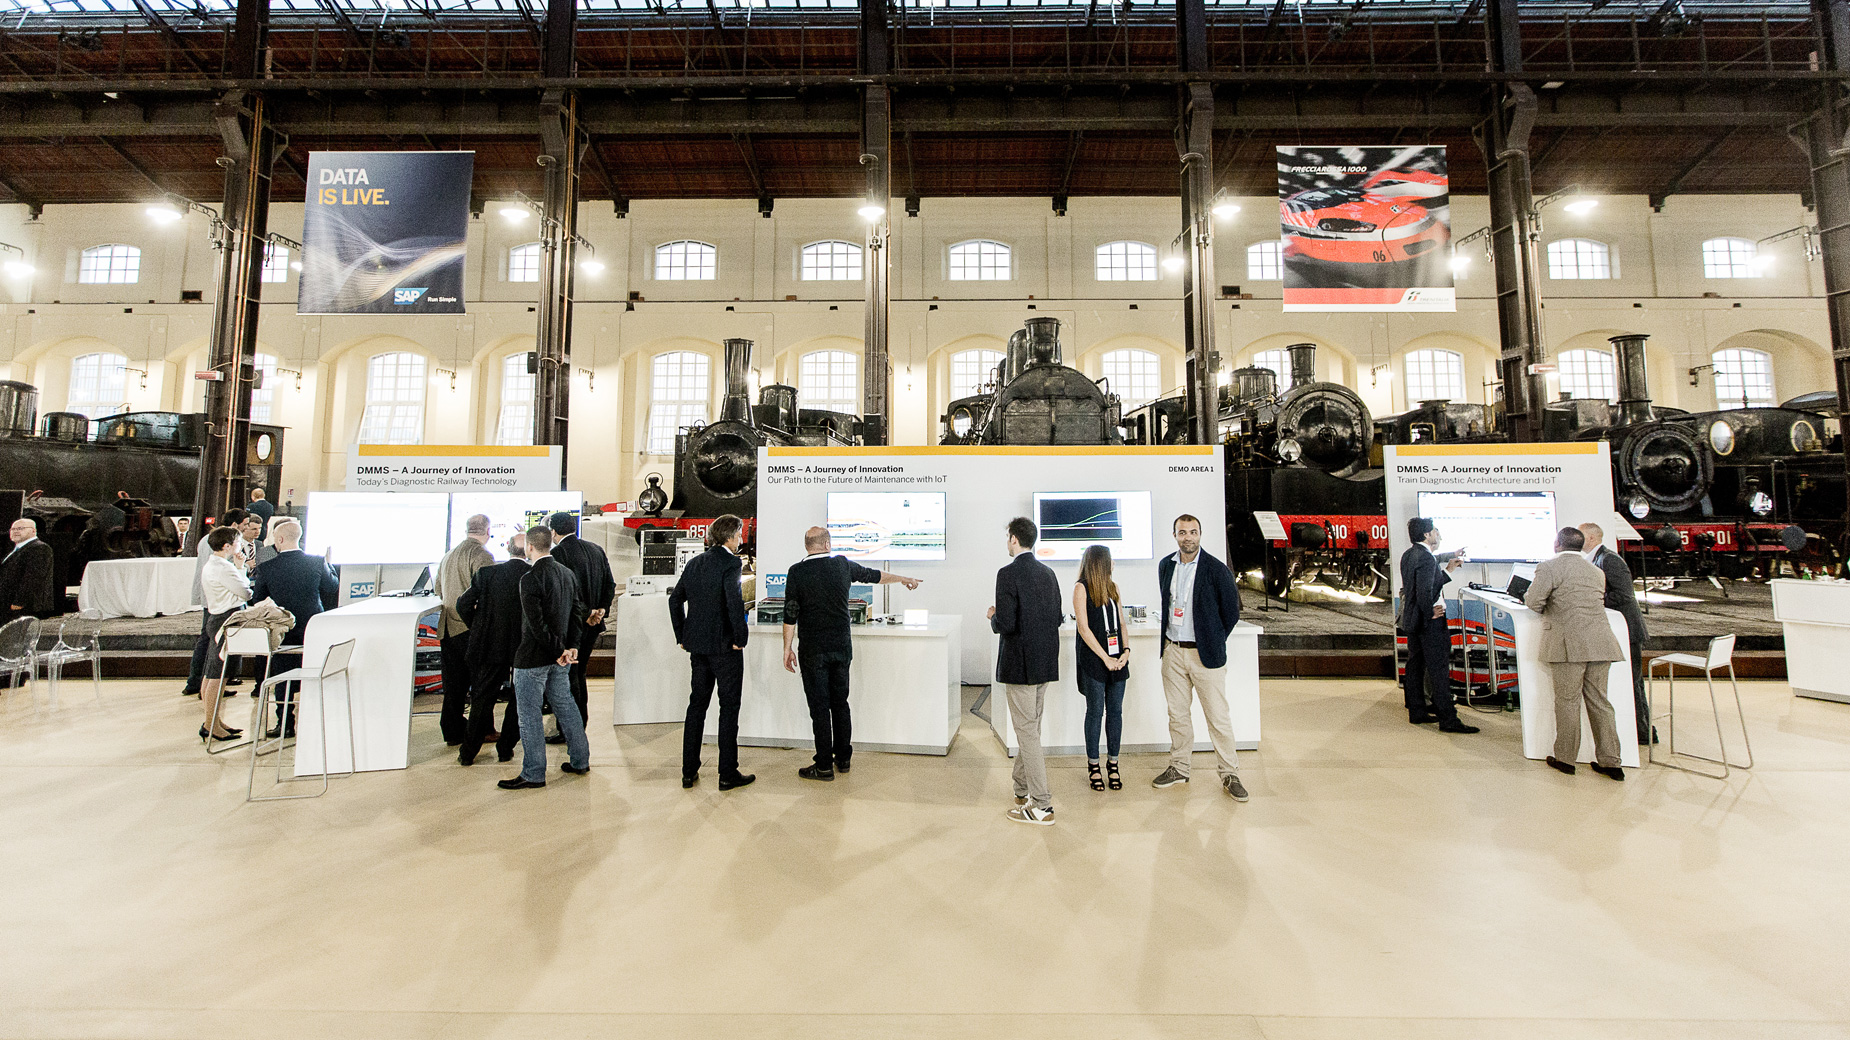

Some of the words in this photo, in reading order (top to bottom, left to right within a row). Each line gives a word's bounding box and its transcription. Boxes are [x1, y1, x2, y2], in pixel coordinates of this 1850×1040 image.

[319, 168, 370, 185] DATA
[318, 188, 337, 205] IS
[341, 188, 390, 205] LIVE.
[1372, 250, 1386, 262] 06
[394, 290, 420, 302] SAP
[357, 466, 390, 475] DMMS
[401, 466, 409, 474] A
[411, 466, 450, 476] Journey
[452, 466, 462, 474] of
[465, 466, 516, 474] Innovation
[767, 465, 795, 473] DMMS
[805, 465, 811, 473] A
[812, 465, 846, 475] Journey
[848, 465, 857, 473] of
[859, 465, 904, 473] Innovation
[1396, 465, 1429, 473] DMMS
[1441, 465, 1448, 473] A
[1450, 465, 1491, 475] Journey
[1493, 465, 1503, 473] of
[1506, 465, 1562, 473] Innovation
[357, 477, 389, 487] Today's
[390, 477, 435, 487] Diagnostic
[437, 477, 469, 487] Railway
[471, 477, 518, 487] Technology
[767, 476, 782, 484] Our
[784, 476, 802, 484] Path
[803, 476, 812, 484] to
[813, 476, 826, 484] the
[828, 476, 853, 484] Future
[854, 475, 863, 484] of
[864, 475, 915, 484] Maintenance
[916, 475, 934, 483] with
[934, 474, 948, 483] IoT
[1397, 476, 1418, 484] Train
[1420, 476, 1465, 486] Diagnostic
[1466, 476, 1522, 485] Architecture
[1523, 476, 1541, 484] and
[1542, 476, 1556, 484] IoT
[766, 576, 787, 585] SAP
[351, 584, 375, 596] SAP
